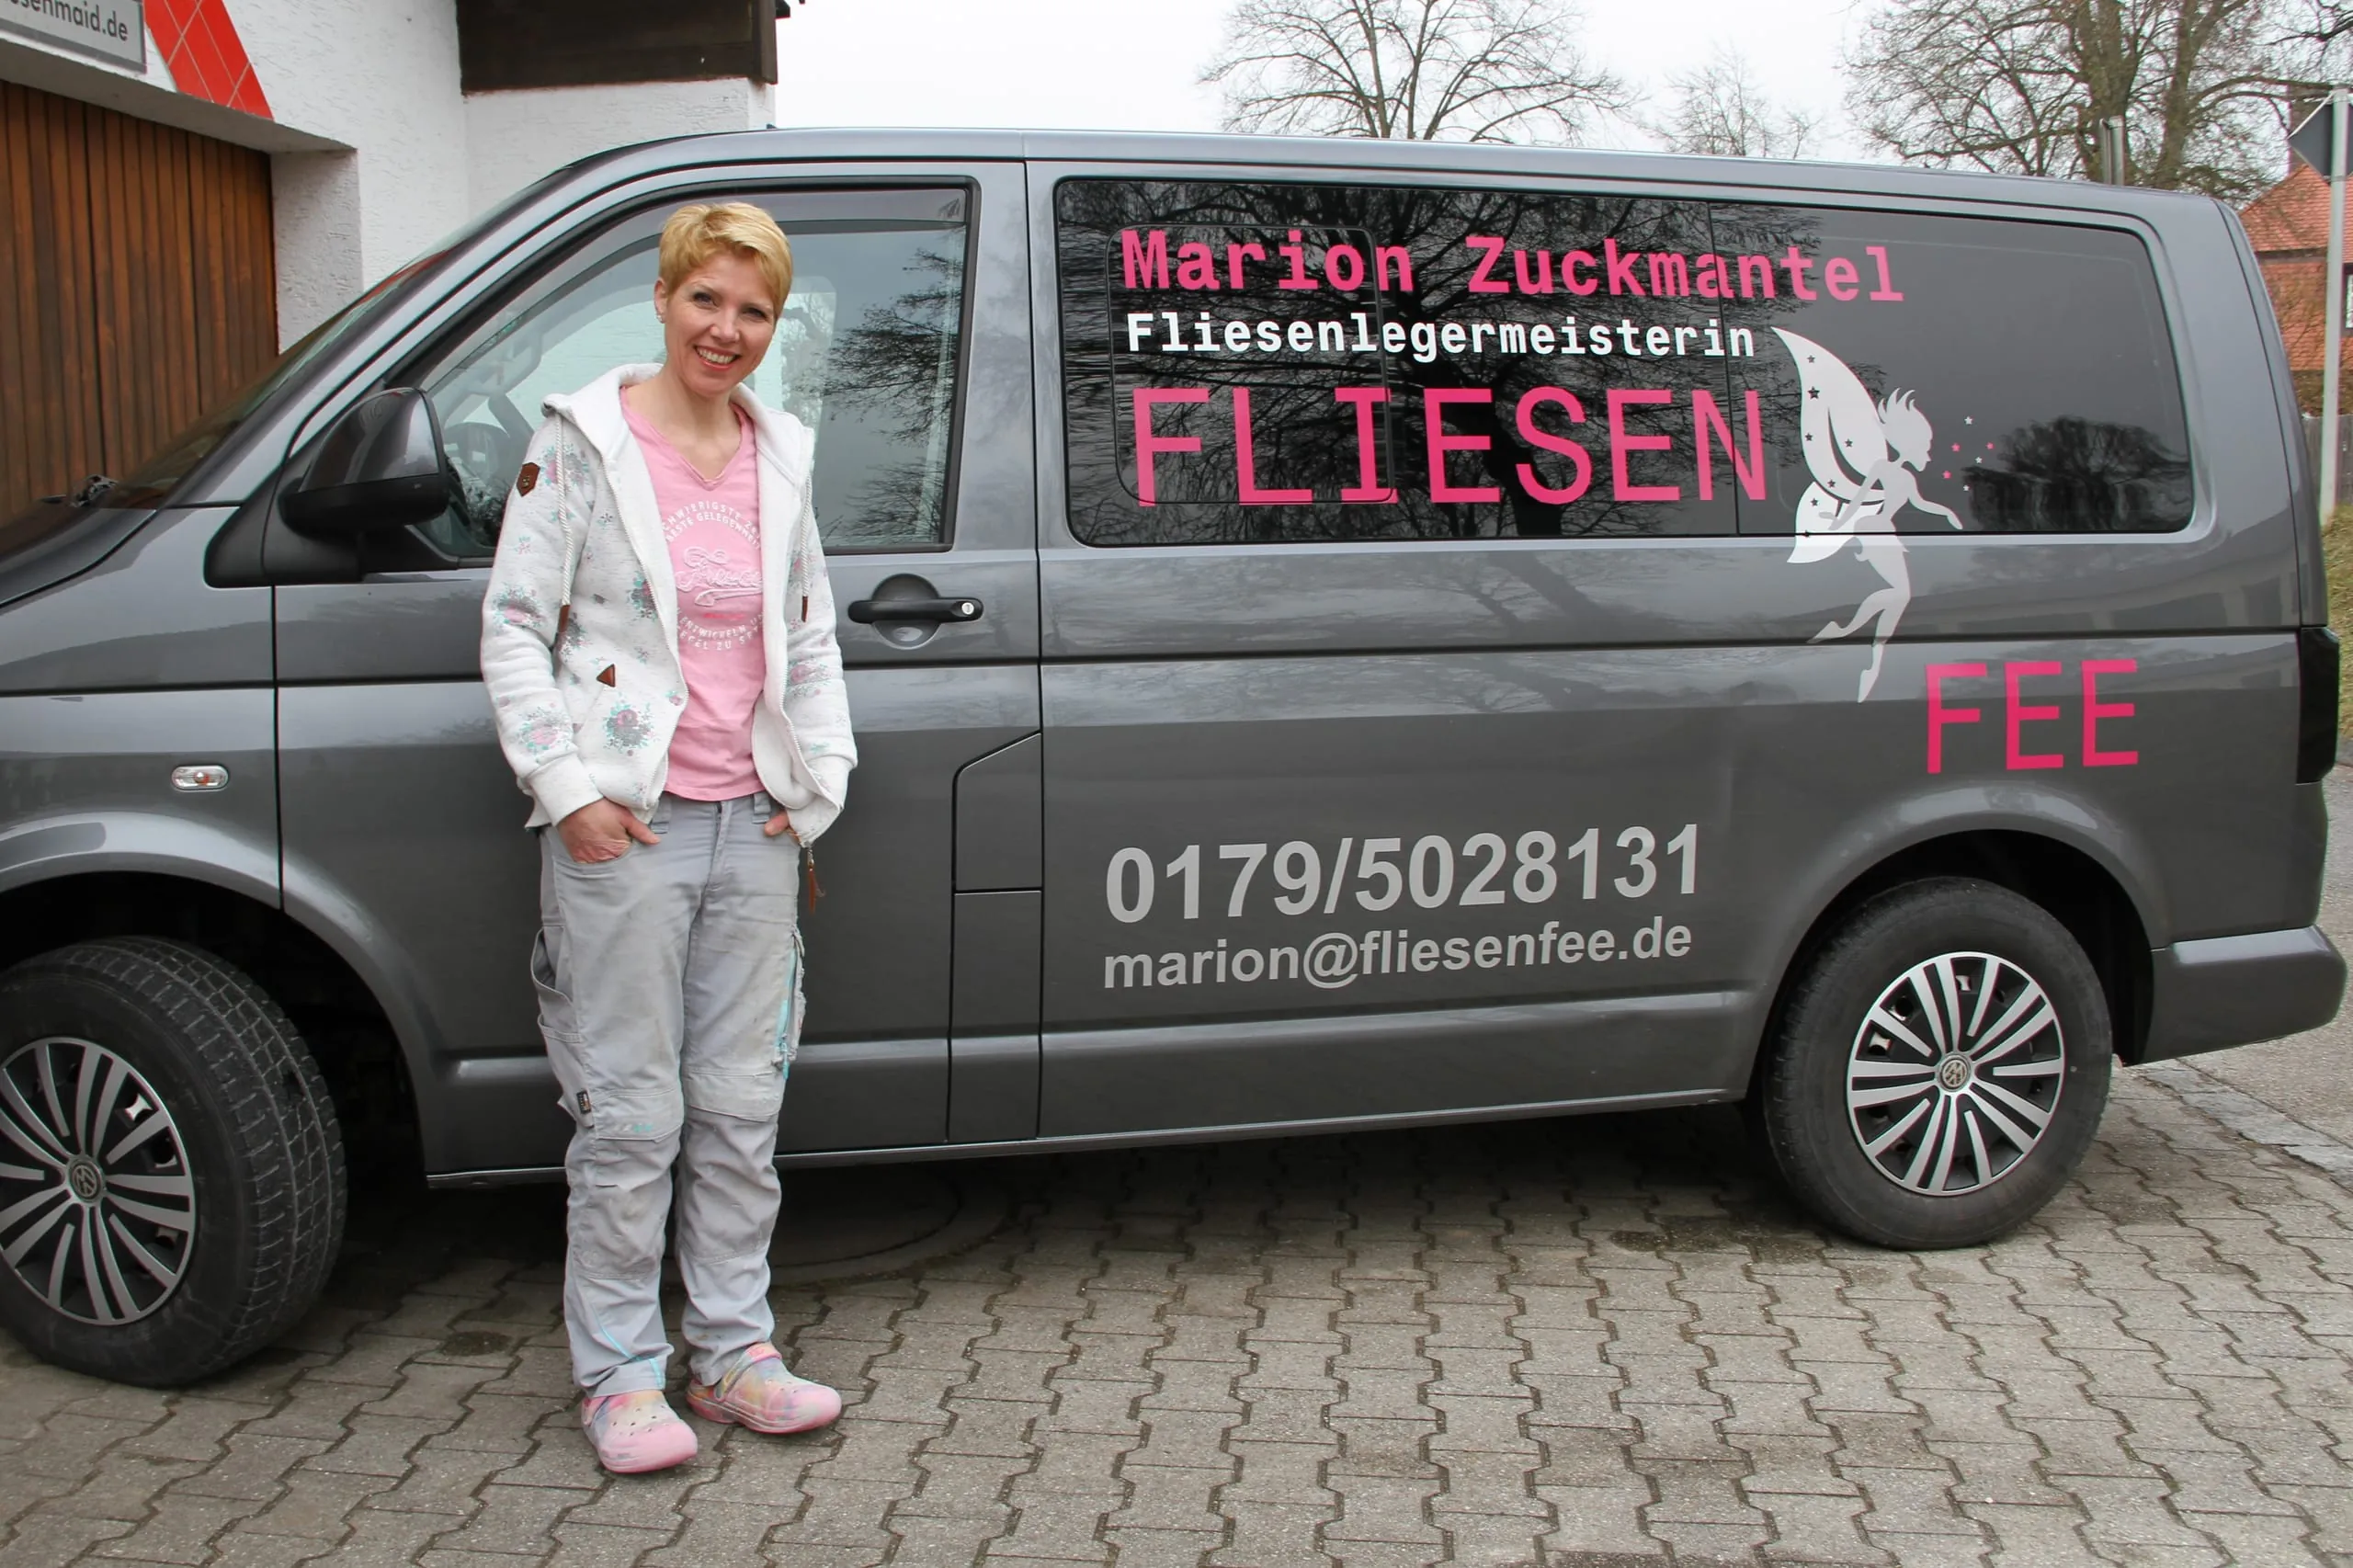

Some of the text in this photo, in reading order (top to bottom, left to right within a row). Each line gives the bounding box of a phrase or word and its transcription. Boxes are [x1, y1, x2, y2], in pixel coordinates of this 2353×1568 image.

[1121, 229, 1904, 301] Marion Zuckmantel
[1127, 312, 1755, 363] Fliesenlegermeisterin
[1132, 385, 1767, 507] FLIESEN
[1926, 658, 2140, 775] FEE
[1107, 824, 1699, 923] 0179/5028131
[1105, 916, 1693, 990] marion@fliesenfee.de
